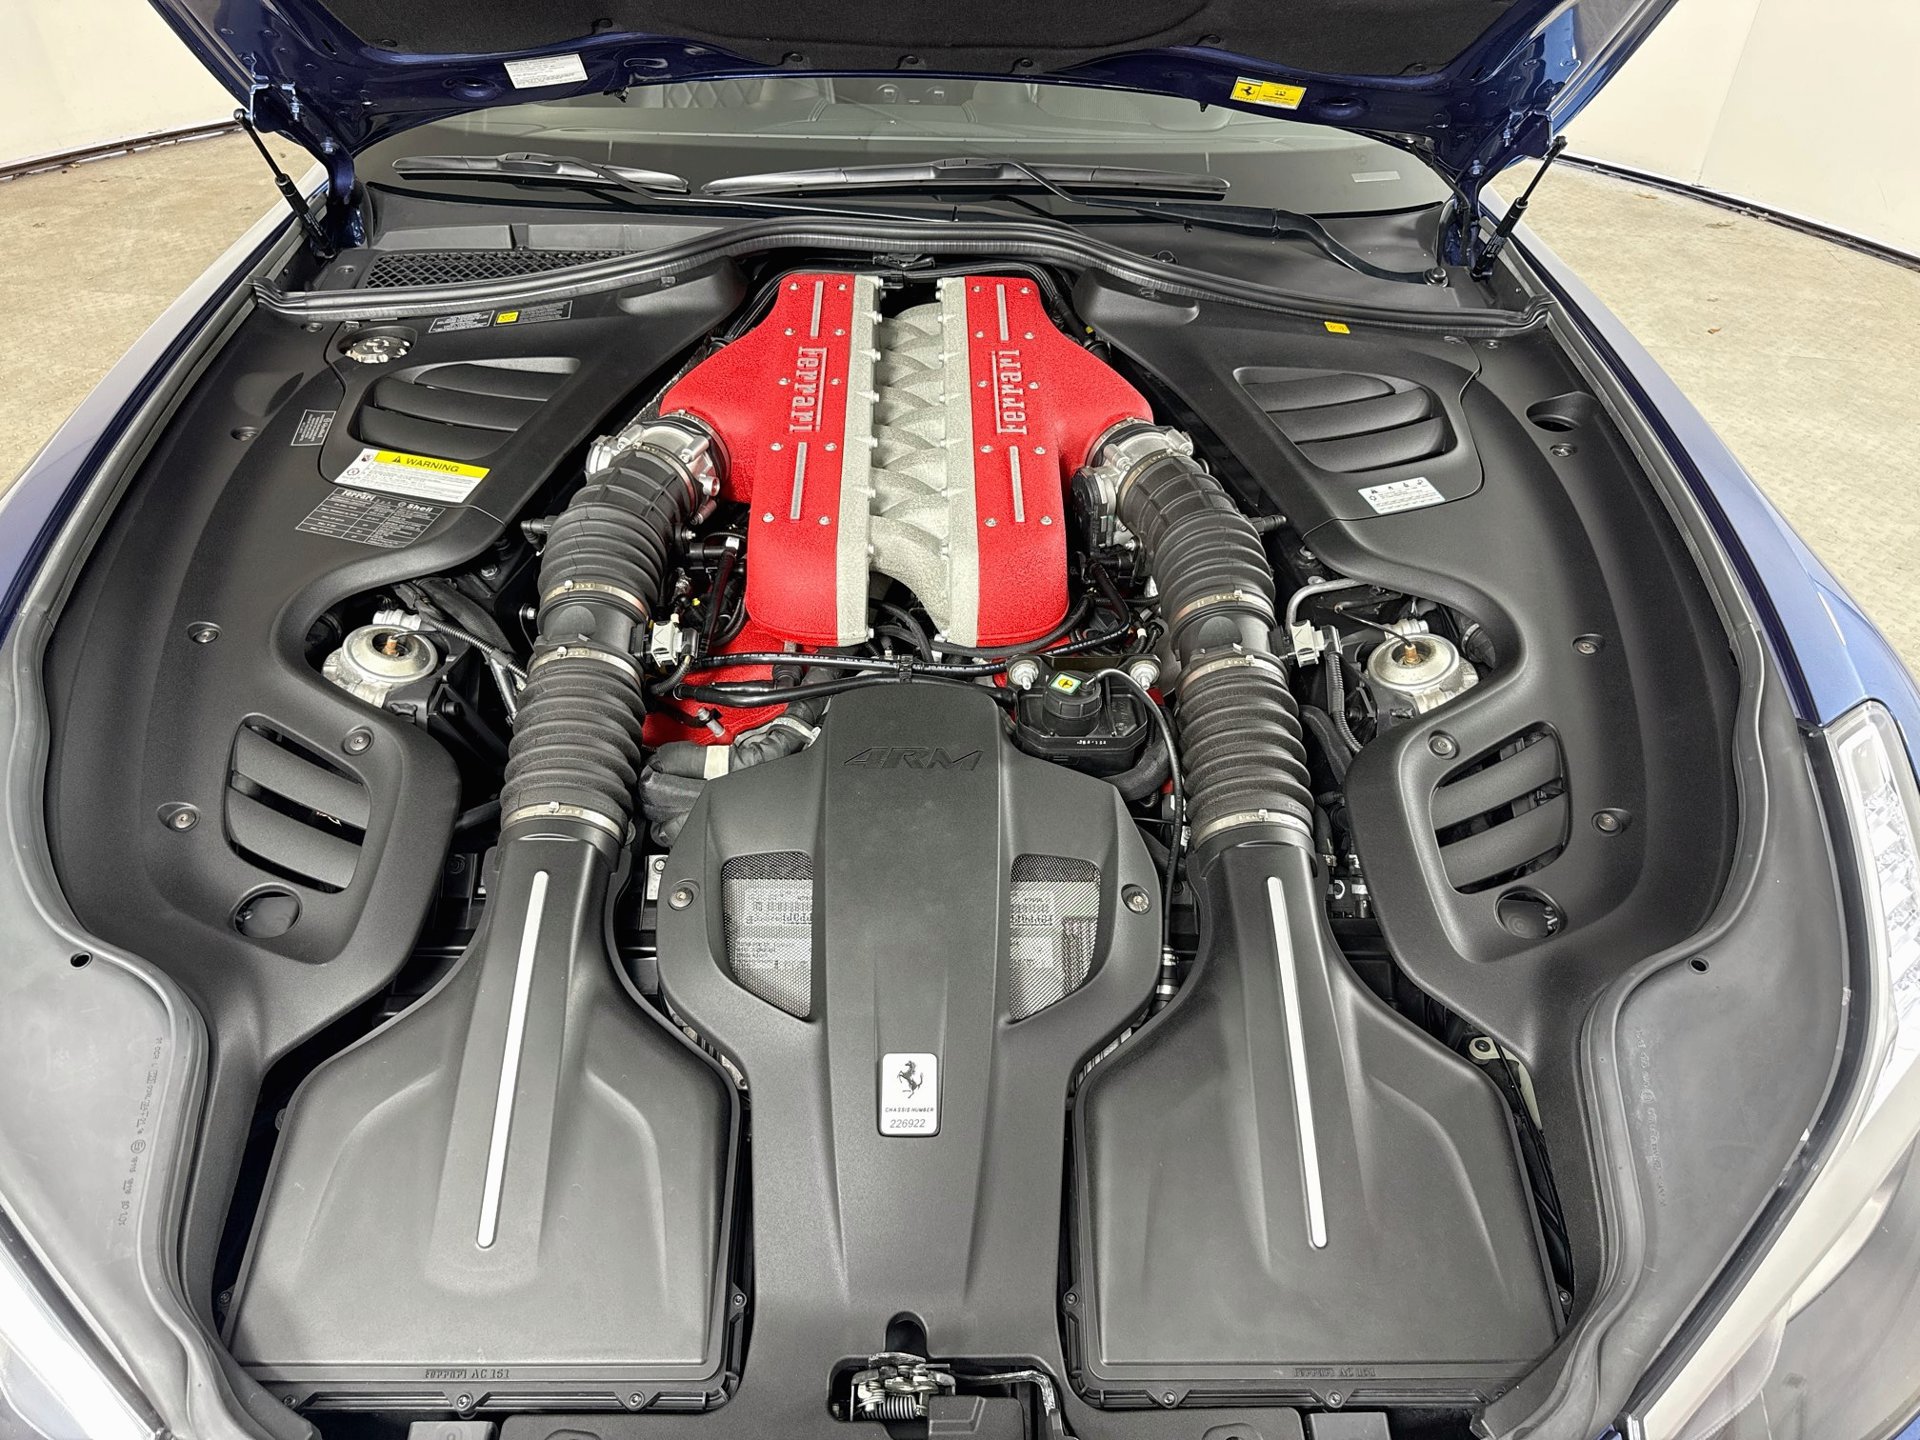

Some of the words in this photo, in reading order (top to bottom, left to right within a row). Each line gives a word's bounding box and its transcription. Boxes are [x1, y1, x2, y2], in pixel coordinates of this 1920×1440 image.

[789, 346, 828, 432] Ferrari
[991, 349, 1028, 435] Ferrari
[406, 457, 460, 473] WARNING
[406, 503, 434, 512] Shell
[840, 747, 984, 771] 4RM
[889, 1118, 926, 1129] 226922
[471, 1368, 488, 1379] AC
[490, 1368, 510, 1379] 151
